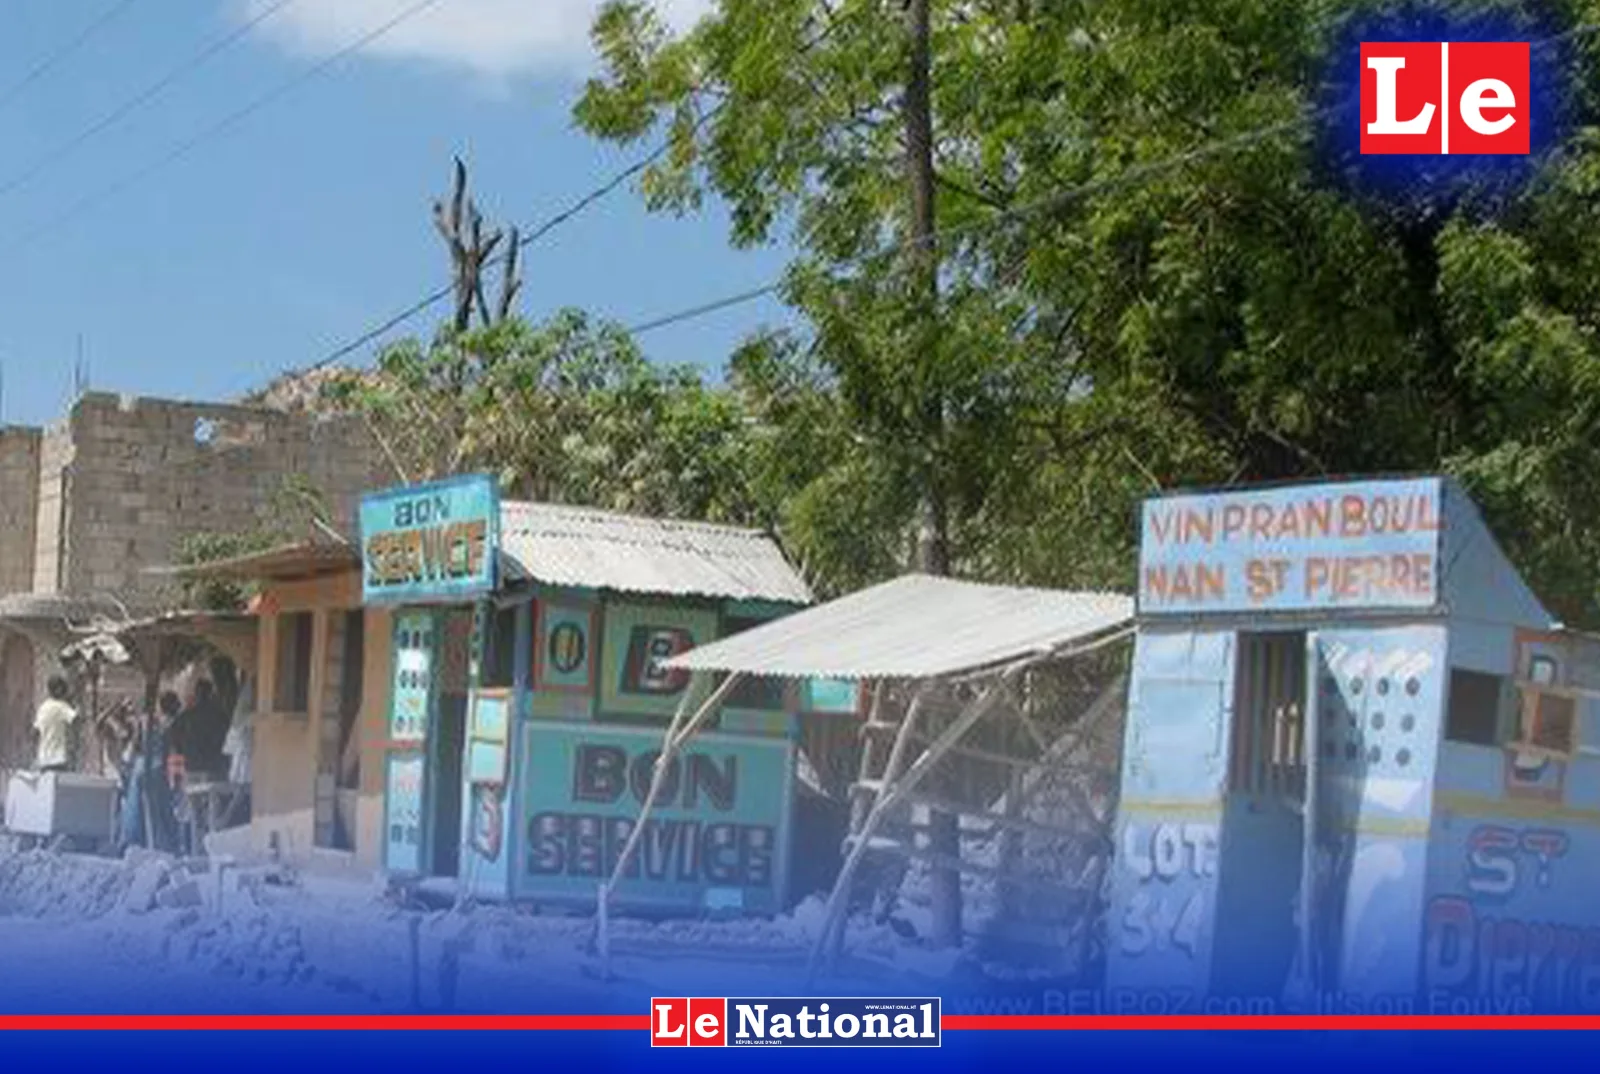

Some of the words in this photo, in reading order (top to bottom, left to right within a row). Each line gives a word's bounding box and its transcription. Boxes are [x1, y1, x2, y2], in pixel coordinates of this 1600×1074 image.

[394, 496, 451, 528] BON
[366, 518, 487, 587] SERVICE
[1304, 553, 1432, 602] PIERRE
[572, 743, 737, 812] BON
[528, 810, 776, 887] SERVICE
